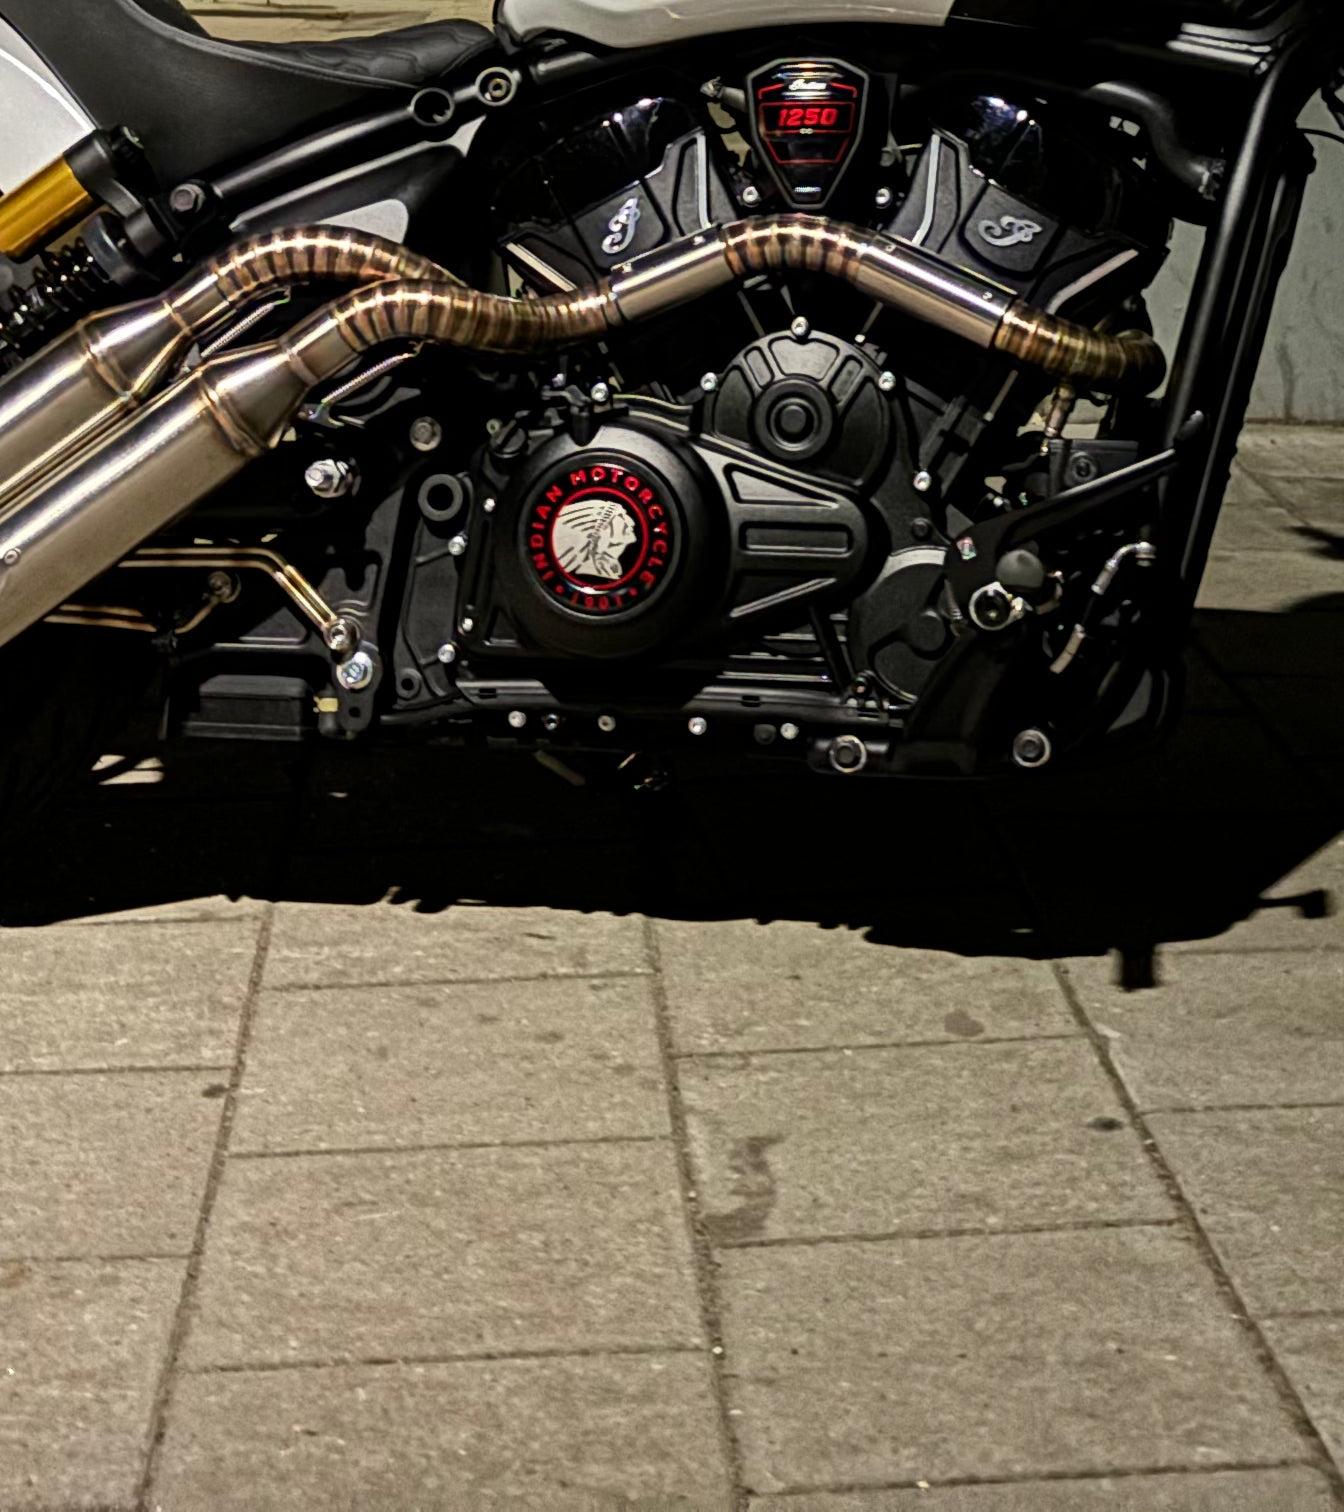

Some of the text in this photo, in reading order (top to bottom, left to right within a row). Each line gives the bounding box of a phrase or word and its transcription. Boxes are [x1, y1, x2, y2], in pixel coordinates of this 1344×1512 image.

[777, 107, 840, 127] 1250
[528, 465, 670, 589] INDIAN MOTORCYCLE
